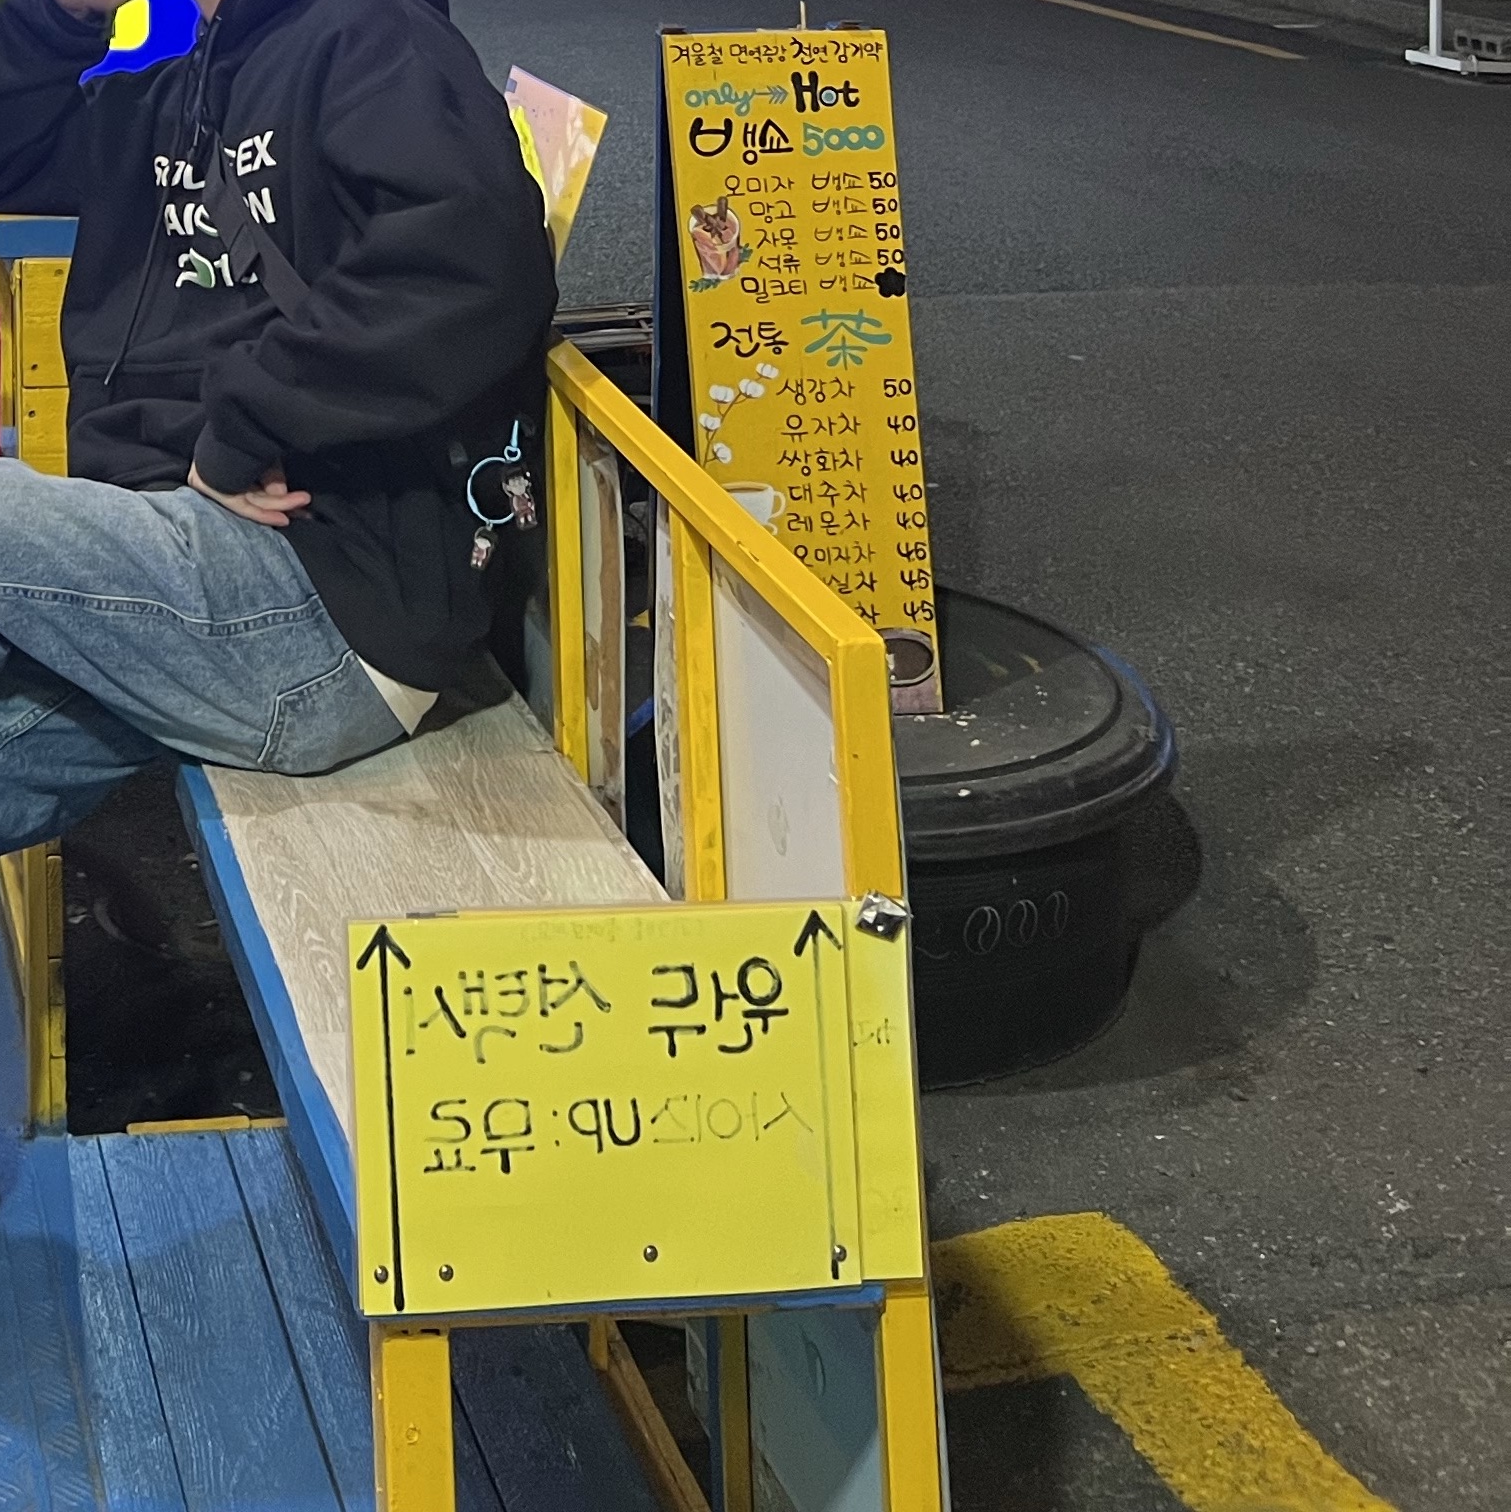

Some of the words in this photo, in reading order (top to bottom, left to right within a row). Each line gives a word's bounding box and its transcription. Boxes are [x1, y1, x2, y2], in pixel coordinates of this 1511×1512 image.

[670, 43, 723, 66] 겨울철
[729, 43, 787, 66] 면역증강
[685, 82, 756, 116] only
[791, 71, 860, 113] Hot
[689, 117, 793, 165] 뱅쇼
[802, 122, 885, 156] 5000
[725, 175, 795, 198] 오미자
[811, 171, 864, 191] 뱅쇼
[749, 201, 796, 223] 망고
[812, 197, 867, 215] 뱅쇼
[756, 228, 798, 250] 자몽
[814, 223, 869, 243] 뱅쇼
[758, 254, 801, 274] 석류
[814, 249, 872, 267] 뱅쇼
[741, 276, 808, 304] 밀크티
[710, 321, 789, 358] 전통
[800, 308, 892, 371] 茶
[776, 378, 856, 406] 생강차
[781, 414, 861, 439] 유자차
[776, 447, 863, 477] 쌍화차
[786, 511, 870, 535] 레몬차
[793, 542, 876, 567] 오미자차
